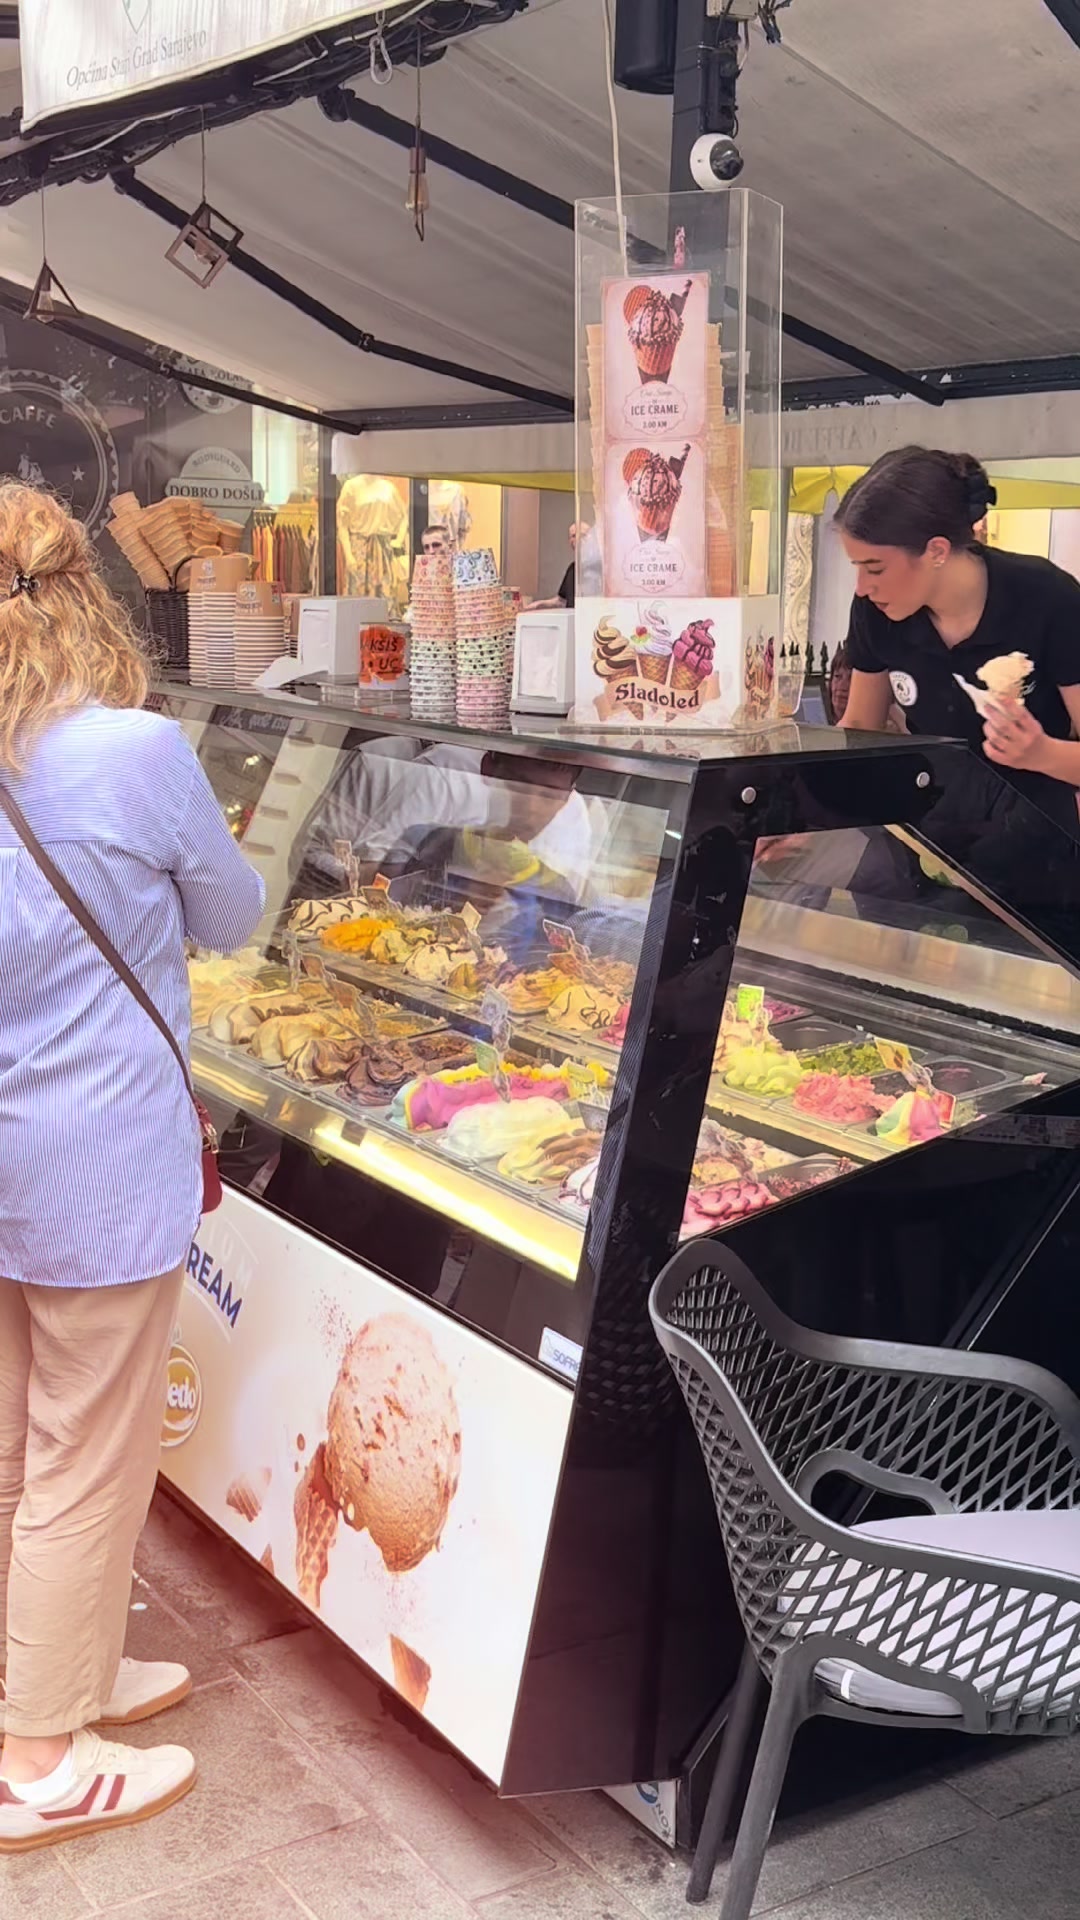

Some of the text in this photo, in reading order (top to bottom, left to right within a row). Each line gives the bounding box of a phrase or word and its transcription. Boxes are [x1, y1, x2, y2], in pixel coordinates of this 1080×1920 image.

[66, 61, 108, 91] Općina
[133, 39, 158, 69] Grad
[161, 30, 207, 60] Sarajevo
[0, 405, 56, 429] CAFFE
[631, 404, 680, 416] ICE CRAME
[170, 485, 219, 498] DOBRO
[630, 563, 678, 572] ICE CRAME
[615, 682, 700, 709] Sladoled
